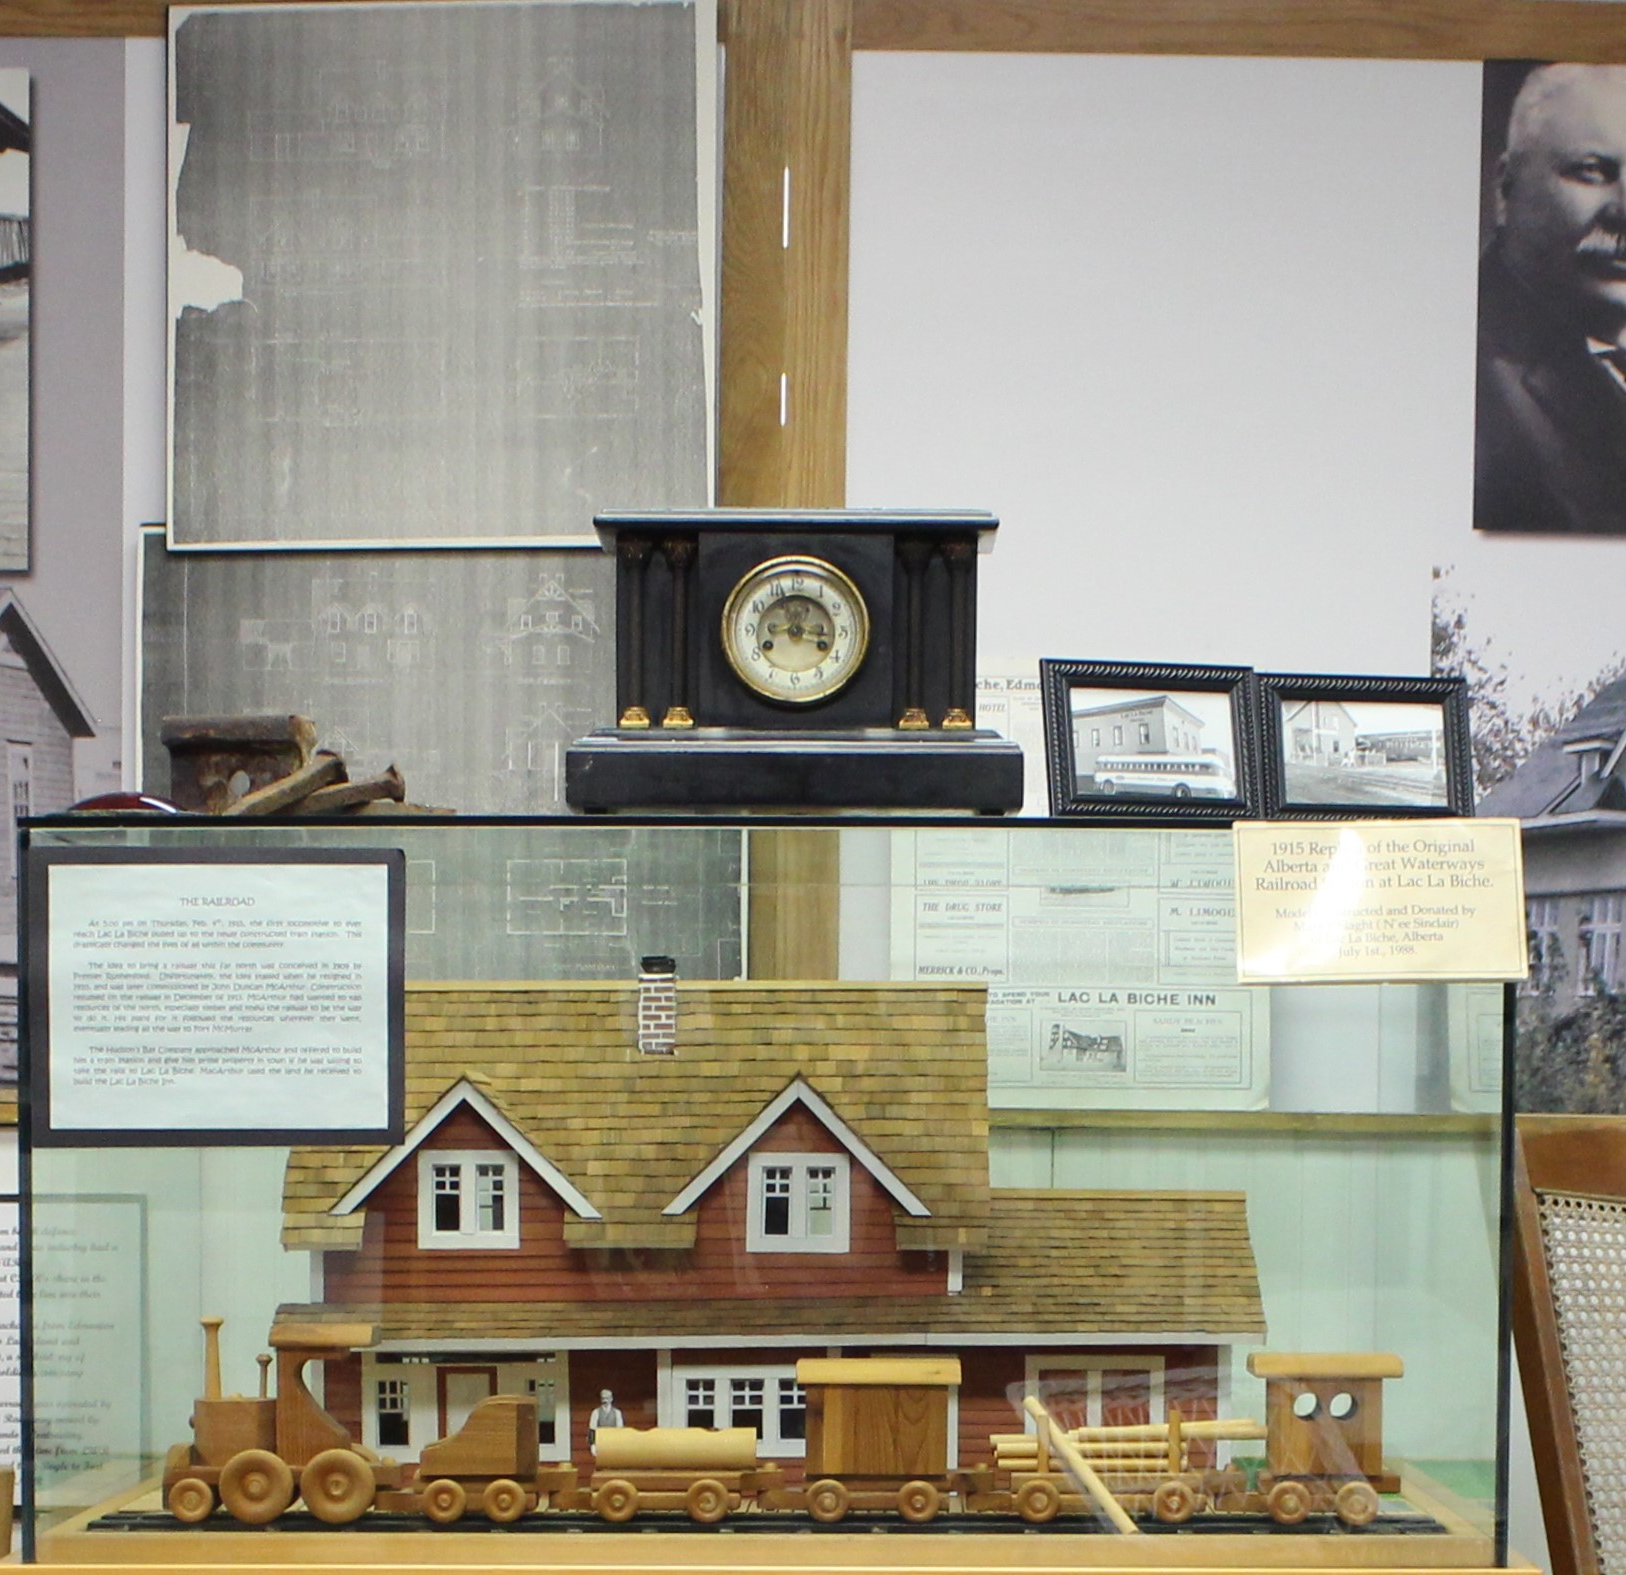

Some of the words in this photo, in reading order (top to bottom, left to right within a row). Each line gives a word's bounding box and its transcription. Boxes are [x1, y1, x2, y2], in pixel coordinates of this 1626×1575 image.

[791, 578, 804, 591] 12
[818, 585, 823, 598] 1
[752, 600, 765, 614] 10
[832, 602, 841, 616] 2
[745, 623, 755, 637] 9
[839, 626, 848, 639] 3
[751, 646, 761, 661] 8
[829, 650, 840, 663] 4
[790, 673, 800, 685] 6
[1271, 842, 1304, 856] 1915
[1367, 840, 1383, 853] of
[1386, 840, 1409, 853] the
[1413, 839, 1475, 856] Original
[1264, 859, 1318, 873] Alberta
[1401, 858, 1485, 875] Waterways
[1255, 876, 1318, 891] Railroad
[1379, 877, 1392, 888] at
[1397, 875, 1422, 888] Lac
[1427, 875, 1445, 888] La
[1450, 875, 1494, 888] Biche.
[179, 897, 199, 906] THE
[202, 897, 255, 906] RAILROAD
[922, 902, 939, 913] THE
[945, 902, 969, 913] DRUG
[975, 902, 1003, 913] STORE
[1386, 905, 1408, 916] and
[1411, 904, 1459, 916] Donated
[1462, 905, 1476, 918] by
[1402, 931, 1444, 943] Alberta
[918, 966, 955, 975] MERRICK
[957, 967, 963, 975] &
[1058, 991, 1090, 1004] LAC
[1098, 992, 1119, 1004] LA
[1127, 993, 1180, 1005] BICHE
[1187, 994, 1216, 1006] INN
